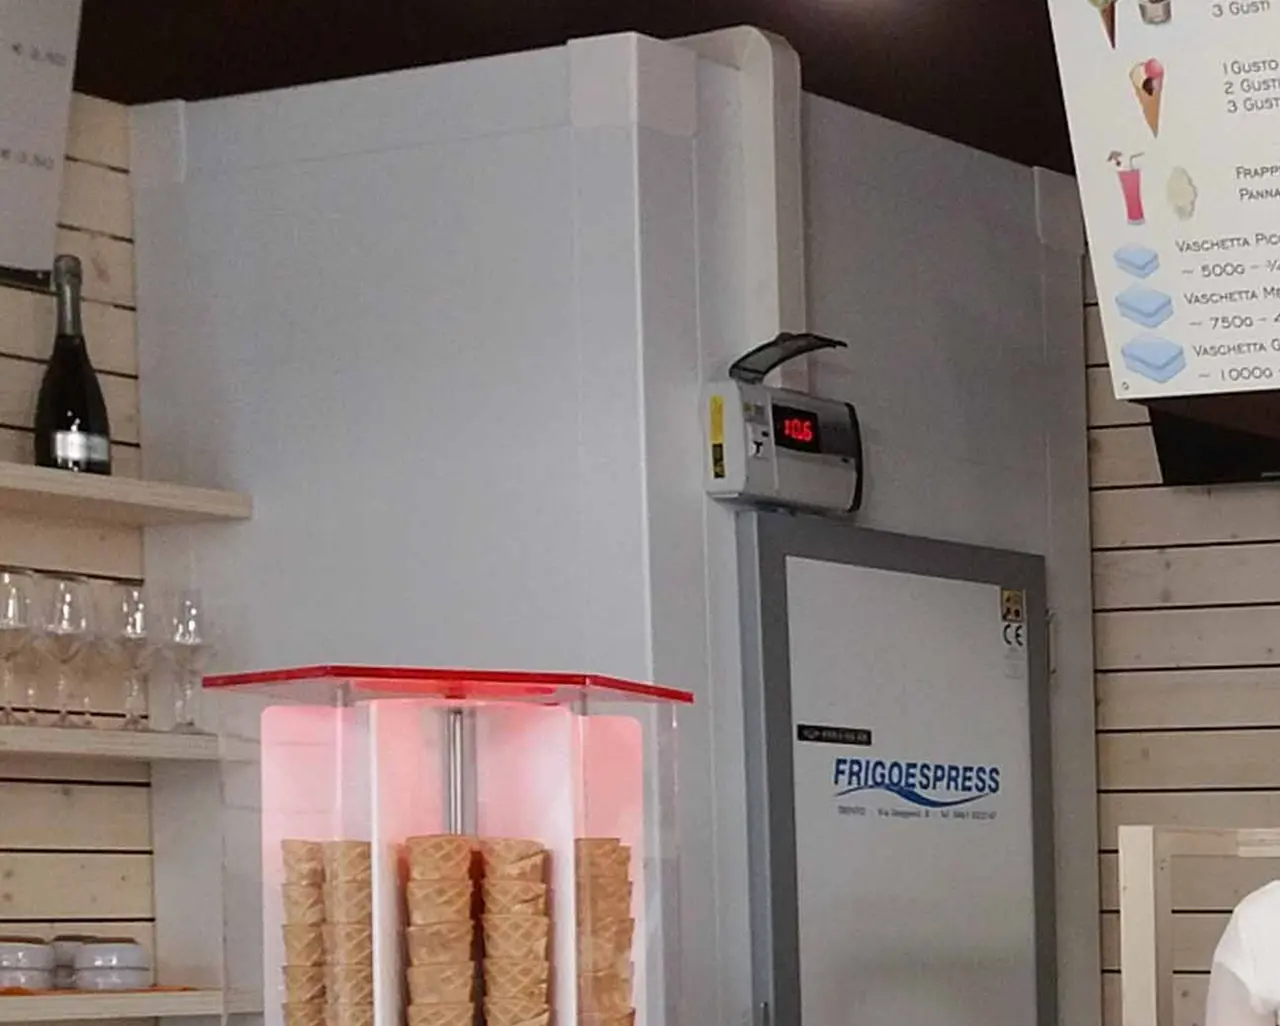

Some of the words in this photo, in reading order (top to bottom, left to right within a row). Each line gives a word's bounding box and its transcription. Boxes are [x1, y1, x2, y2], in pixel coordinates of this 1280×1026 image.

[1212, 3, 1223, 18] 3
[1224, 81, 1235, 95] 2
[1227, 100, 1238, 114] 3
[833, 758, 1001, 794] FRIGOESPRESS
